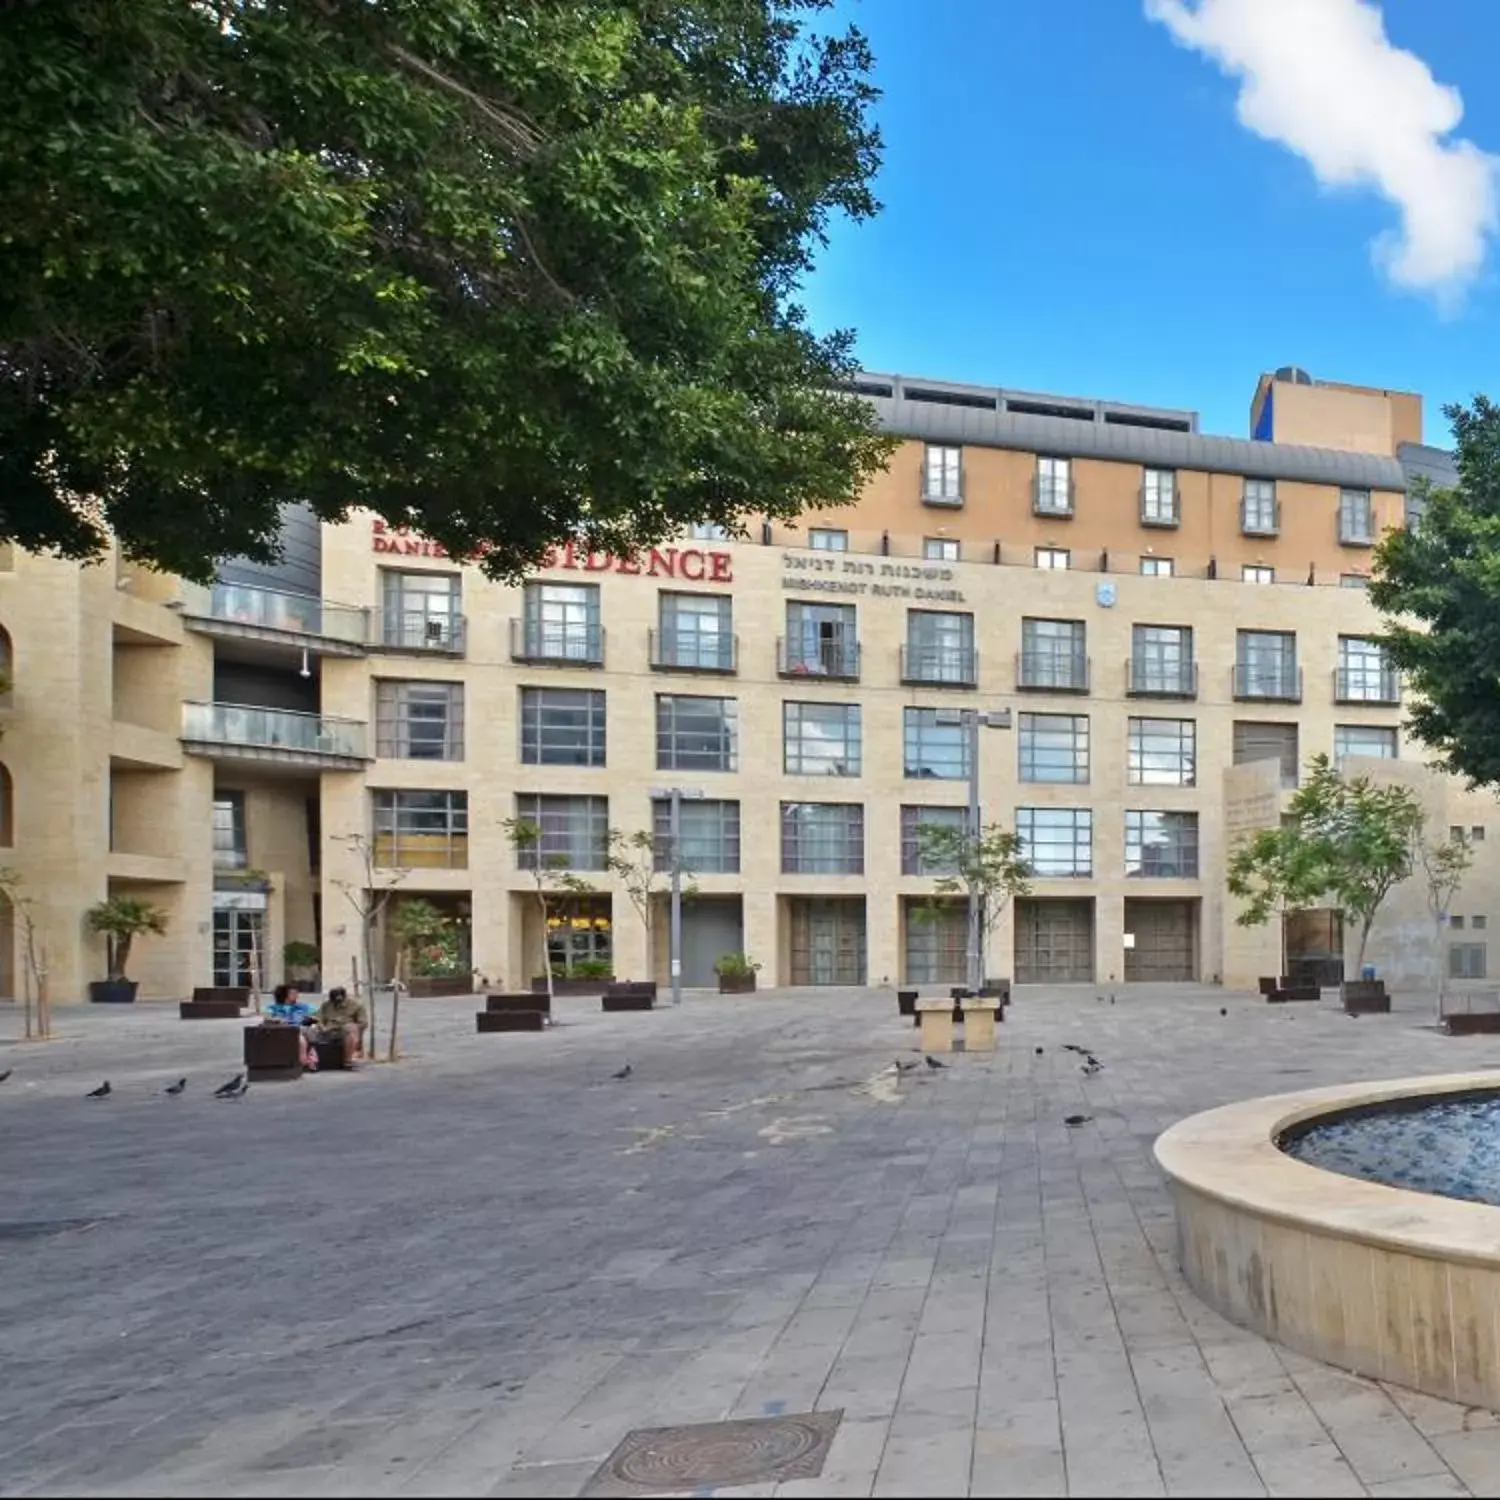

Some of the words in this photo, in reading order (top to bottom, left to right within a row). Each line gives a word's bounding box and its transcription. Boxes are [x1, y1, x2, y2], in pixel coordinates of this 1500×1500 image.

[373, 537, 447, 558] DANIE
[783, 553, 836, 572] דניאל
[842, 560, 875, 577] רות
[880, 563, 954, 581] משכנות
[870, 583, 911, 600] RUTH
[914, 586, 966, 604] DANIEL
